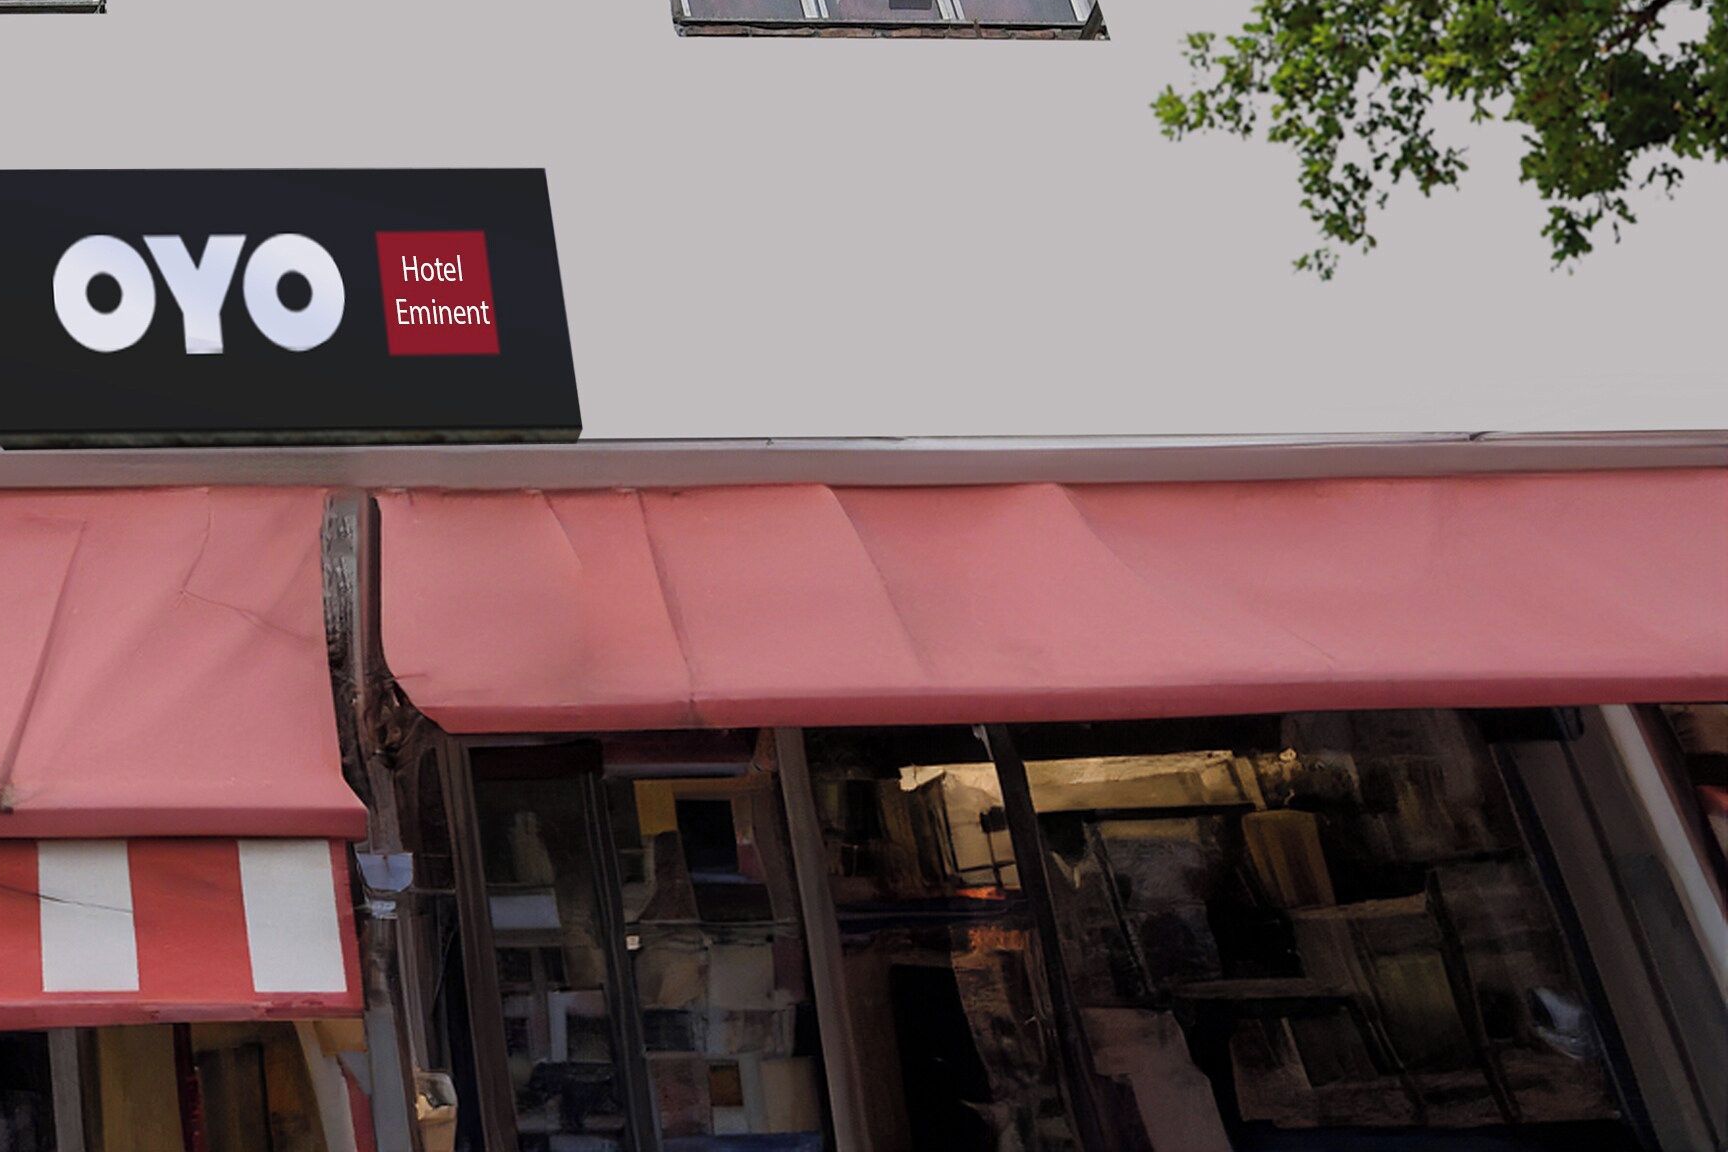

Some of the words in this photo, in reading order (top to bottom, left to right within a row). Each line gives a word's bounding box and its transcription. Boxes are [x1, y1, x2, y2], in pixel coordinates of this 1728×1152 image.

[401, 254, 464, 282] Hotel
[53, 233, 346, 355] OYO
[395, 298, 491, 325] Eminent
